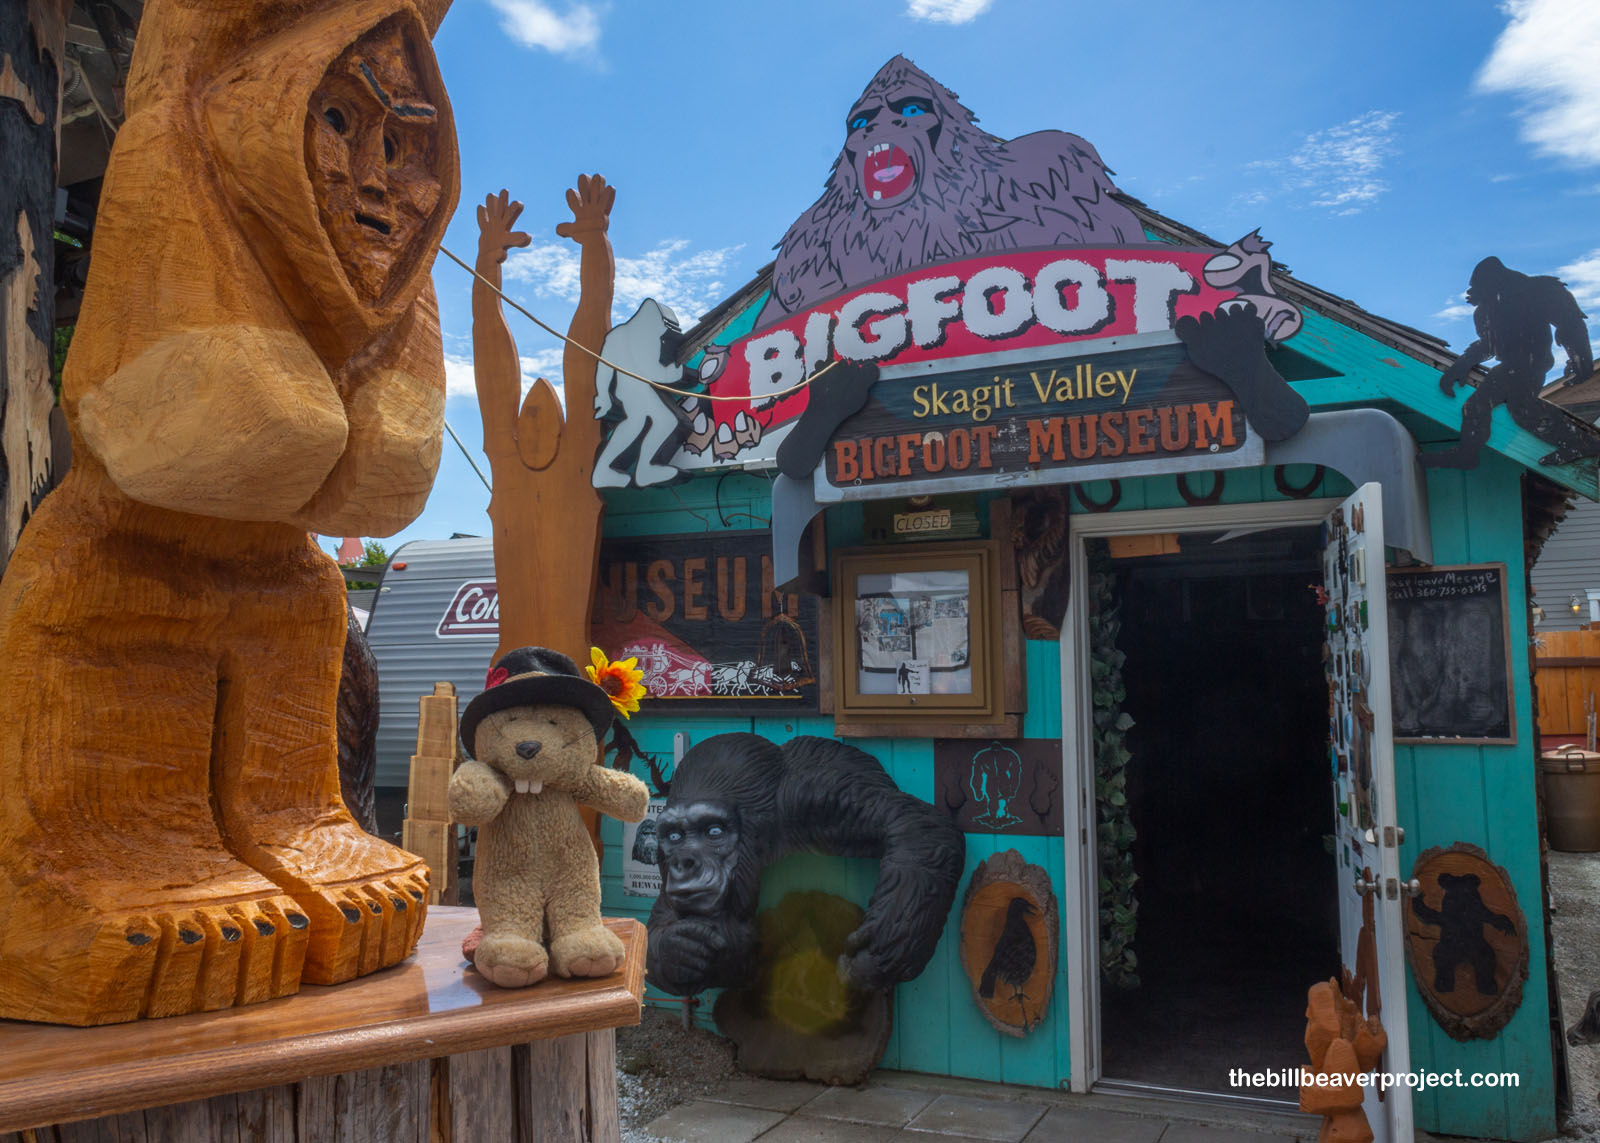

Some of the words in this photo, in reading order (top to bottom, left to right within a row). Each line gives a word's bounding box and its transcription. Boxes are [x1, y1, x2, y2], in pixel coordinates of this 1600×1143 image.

[744, 257, 1198, 412] BIGFOOT
[912, 376, 1016, 422] Skagit
[1030, 363, 1138, 404] Valley
[834, 425, 998, 483] BIGFOOT
[1026, 400, 1238, 464] MUSEUM
[896, 514, 951, 531] CLOSED
[608, 554, 799, 624] USEUM
